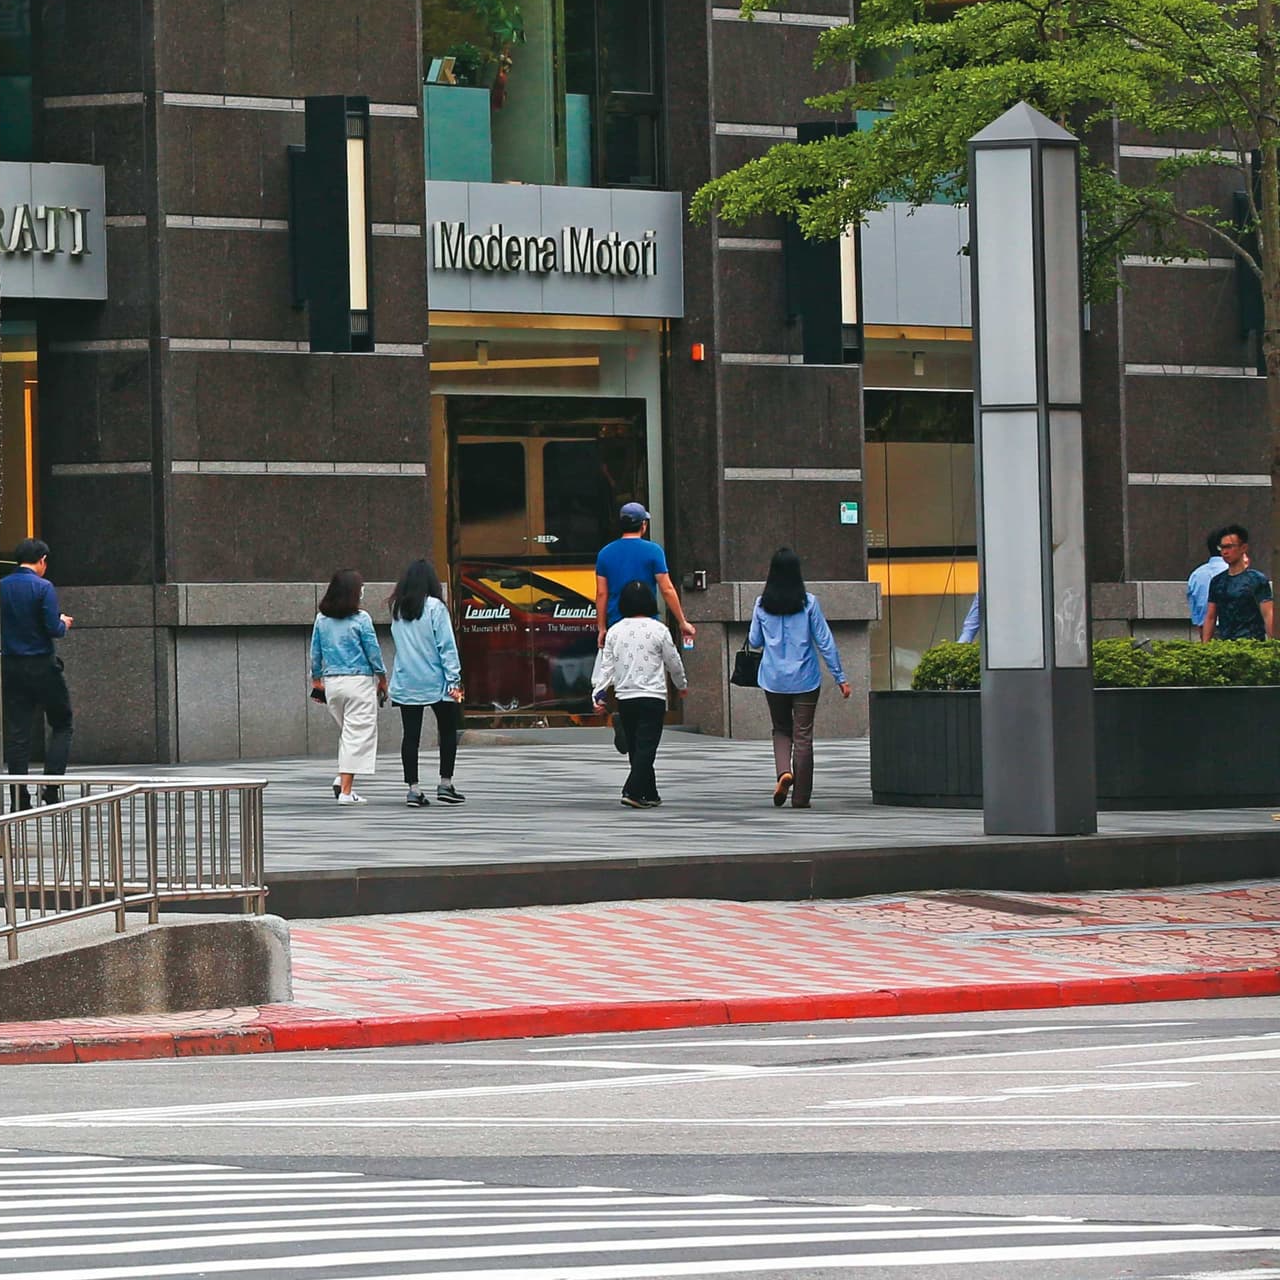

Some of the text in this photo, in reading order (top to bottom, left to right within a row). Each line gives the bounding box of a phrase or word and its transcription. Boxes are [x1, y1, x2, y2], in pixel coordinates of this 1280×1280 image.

[433, 221, 657, 276] Modena Motori
[465, 604, 511, 619] Levante
[553, 604, 597, 618] Levante
